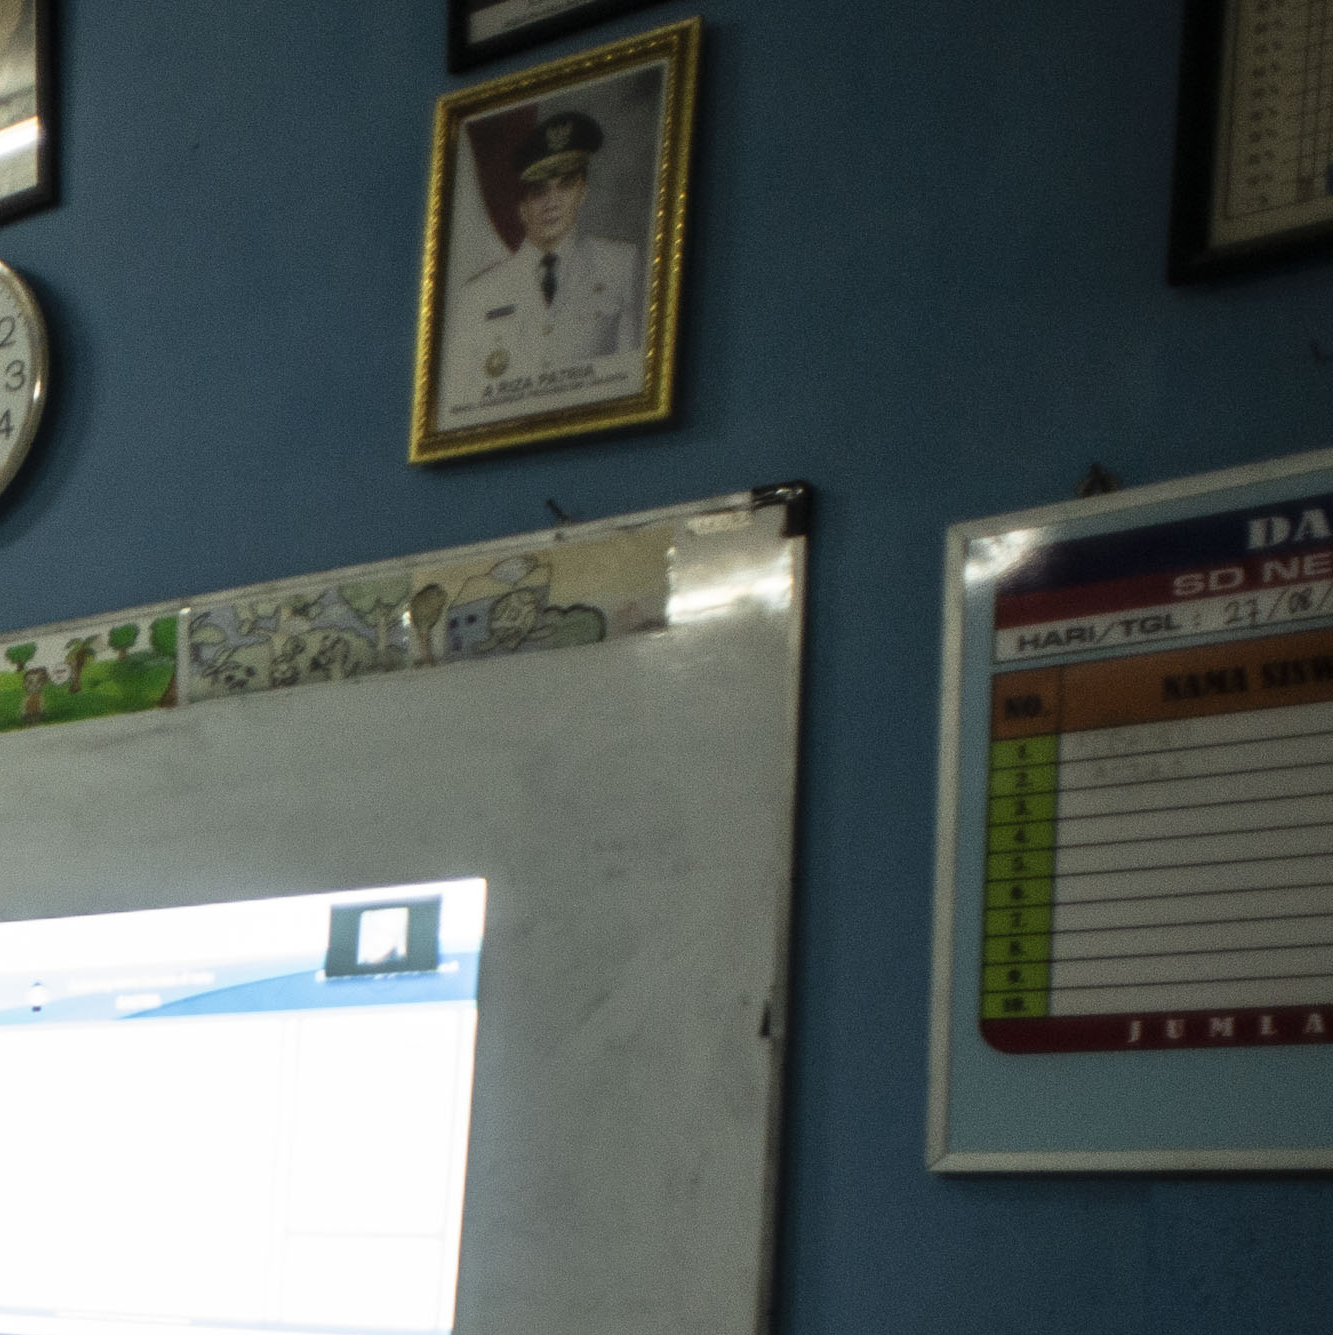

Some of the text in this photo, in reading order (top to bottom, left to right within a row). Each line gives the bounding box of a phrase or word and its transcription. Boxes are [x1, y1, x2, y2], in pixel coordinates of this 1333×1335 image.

[5, 360, 26, 392] 3
[1172, 567, 1245, 597] SD
[1018, 613, 1183, 651] HARI/TGL
